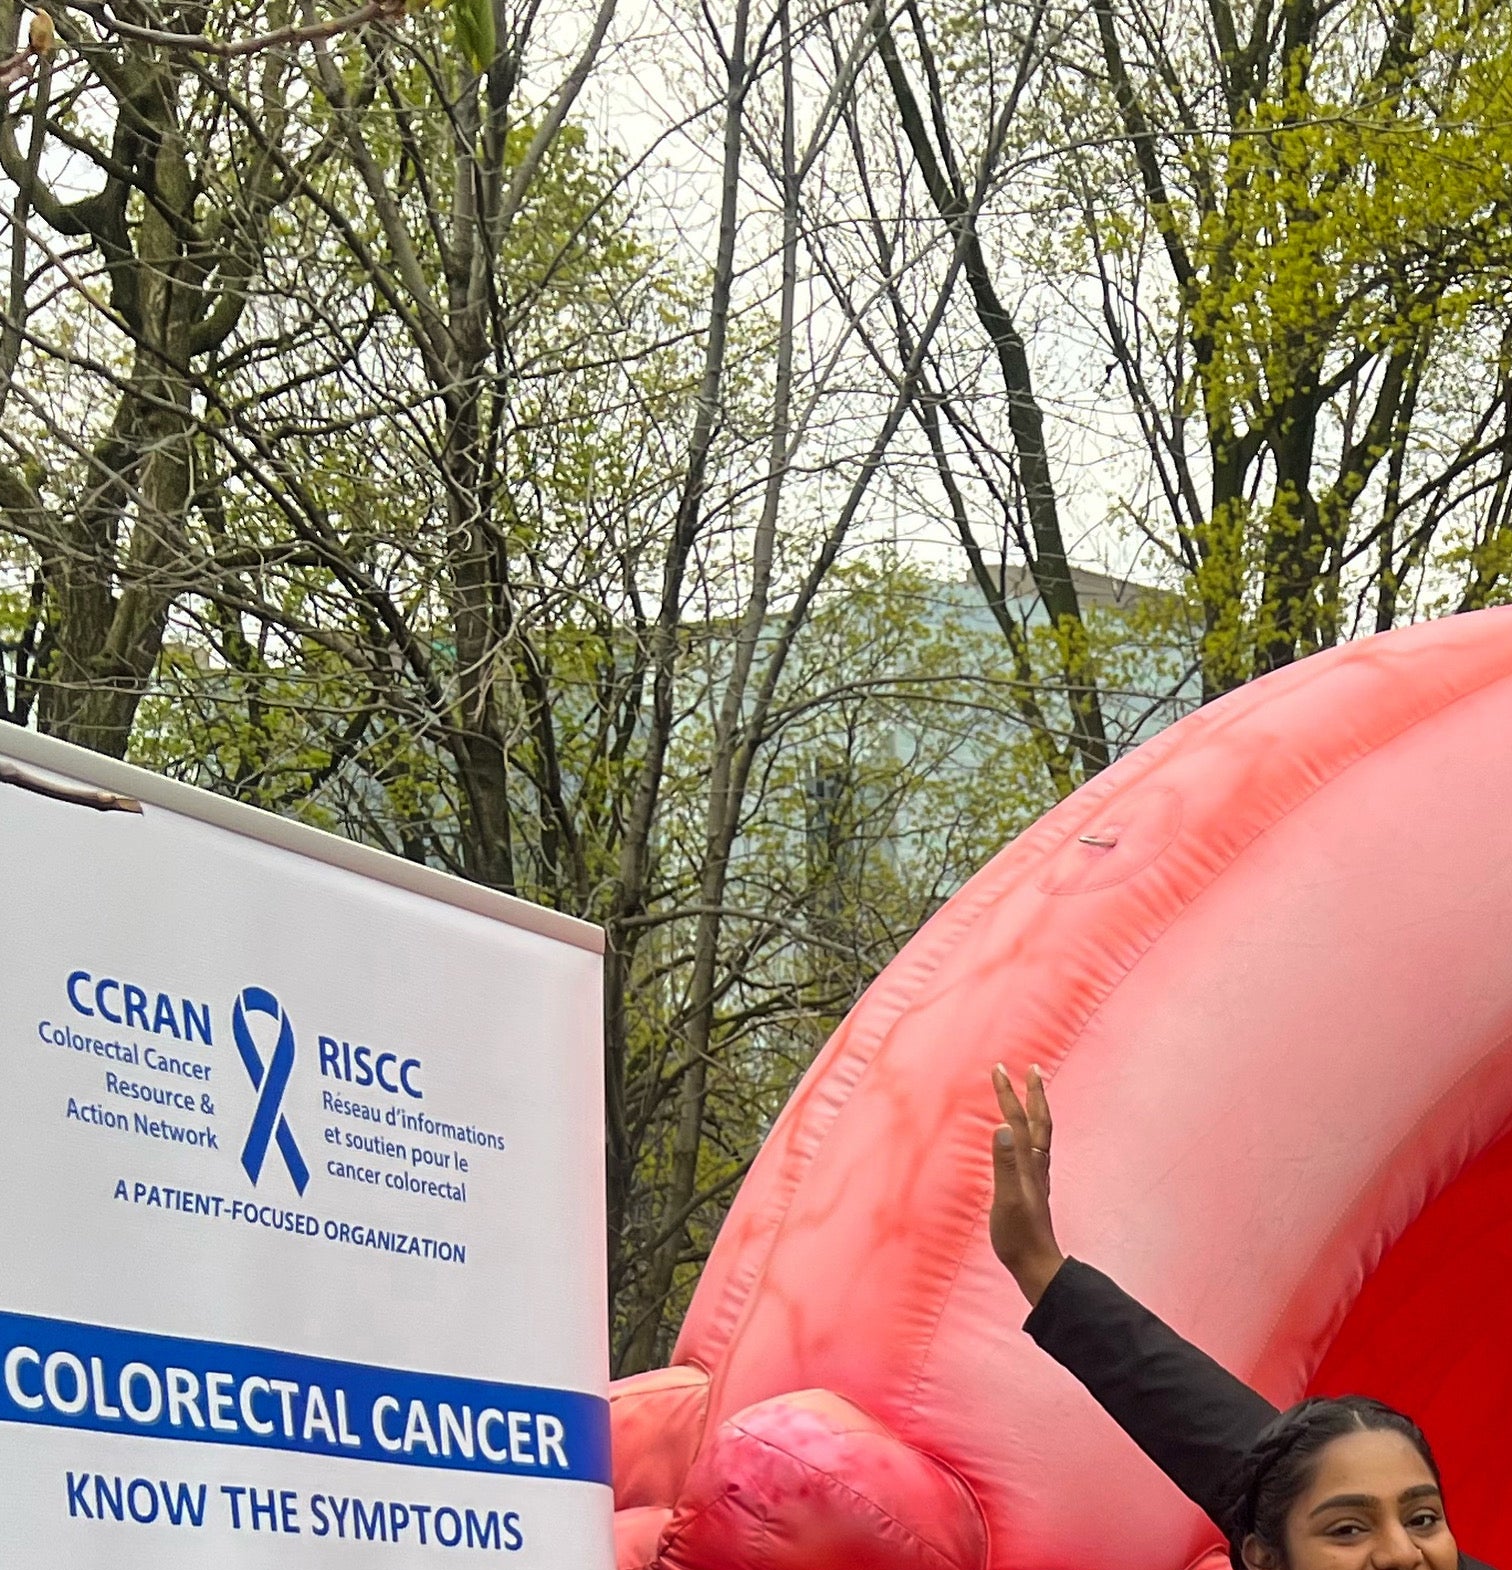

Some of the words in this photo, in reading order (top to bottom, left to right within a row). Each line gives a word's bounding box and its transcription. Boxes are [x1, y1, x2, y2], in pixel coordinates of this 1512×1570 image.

[66, 970, 213, 1046] CCRAN
[38, 1021, 139, 1066] Colorectal
[144, 1047, 211, 1081] Cancer
[317, 1035, 423, 1099] RISCC
[106, 1071, 194, 1113] Resource
[199, 1091, 215, 1116] &
[322, 1090, 381, 1125] Réseau
[386, 1105, 505, 1151] d'informations
[66, 1098, 129, 1132] Action
[134, 1109, 219, 1151] Network
[325, 1126, 341, 1146] et
[345, 1128, 406, 1160] soutien
[411, 1146, 449, 1174] pour
[453, 1150, 469, 1173] le
[326, 1157, 381, 1186] cancer
[385, 1166, 467, 1203] colorectal
[114, 1180, 129, 1201] A
[134, 1182, 319, 1237] PATIENT-FOCUSED
[324, 1220, 467, 1264] ORGANIZATION
[4, 1345, 361, 1447] COLORECTAL
[372, 1398, 568, 1468] CANCER
[66, 1471, 207, 1527] KNOW
[221, 1484, 301, 1534] THE
[310, 1494, 524, 1551] SYMPTOMS
